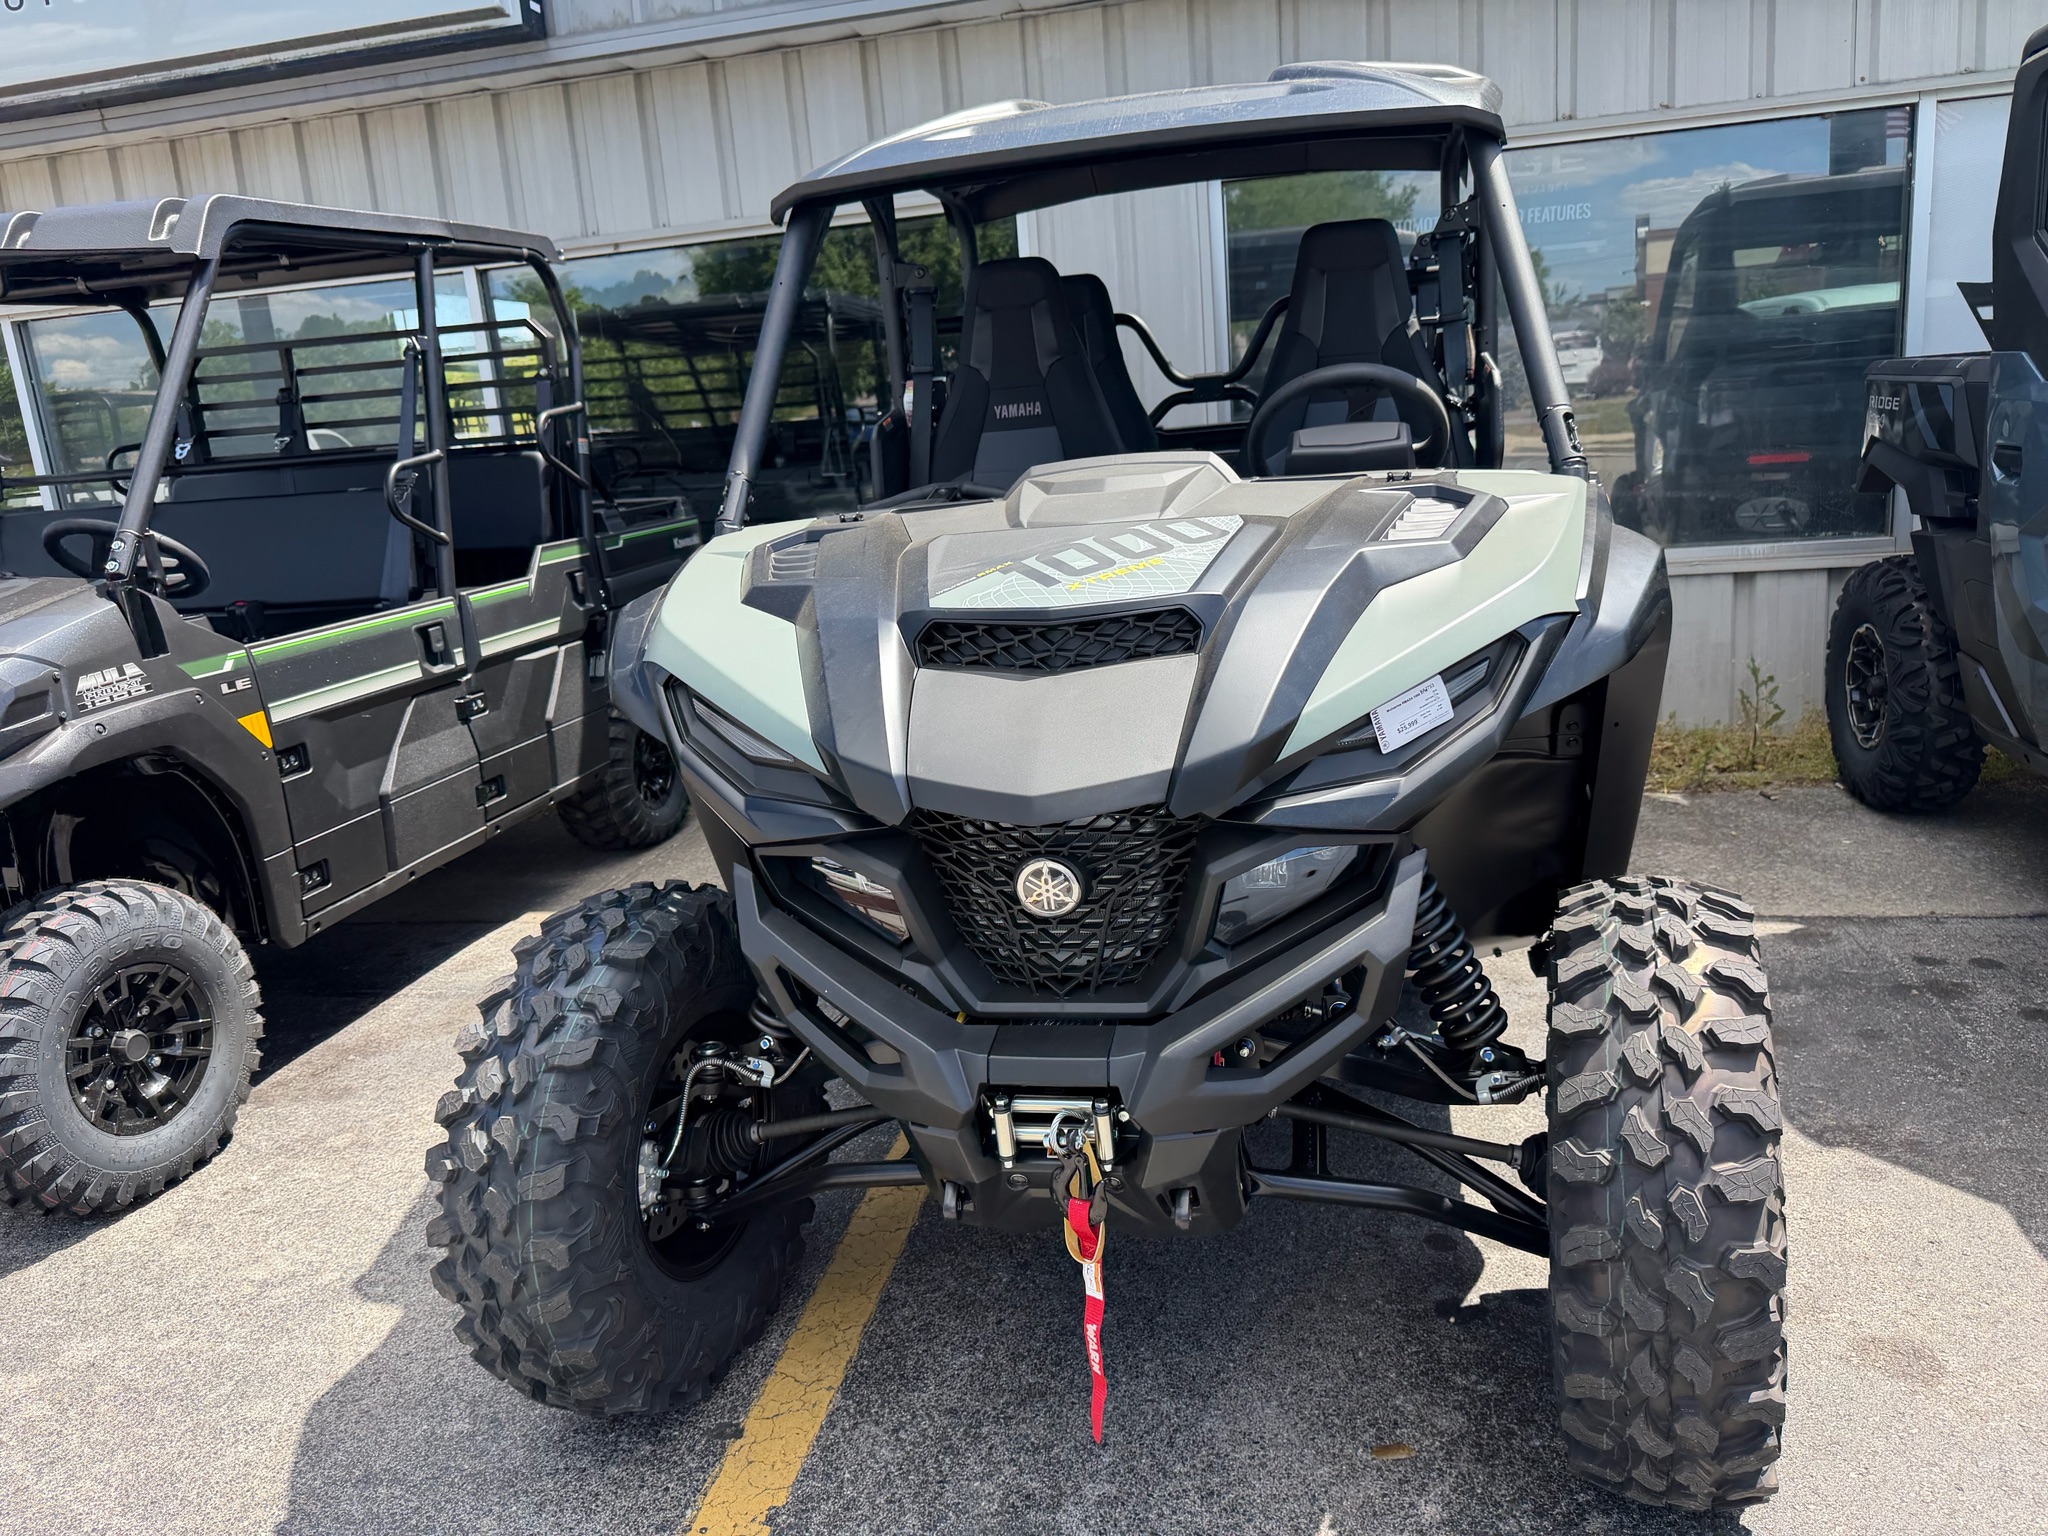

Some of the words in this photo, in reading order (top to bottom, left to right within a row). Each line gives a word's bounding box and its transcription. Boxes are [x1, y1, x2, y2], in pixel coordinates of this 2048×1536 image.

[1528, 203, 1592, 223] FEATURES
[994, 401, 1042, 419] YAMAHA
[1869, 395, 1900, 410] RIDGE
[999, 519, 1231, 588] 1000
[1065, 556, 1165, 592] XTREME
[75, 662, 147, 696] MULE
[220, 677, 252, 695] LE
[1371, 709, 1387, 742] YAMAHA
[1397, 719, 1418, 734] $25,999
[1086, 1323, 1102, 1376] WARN
